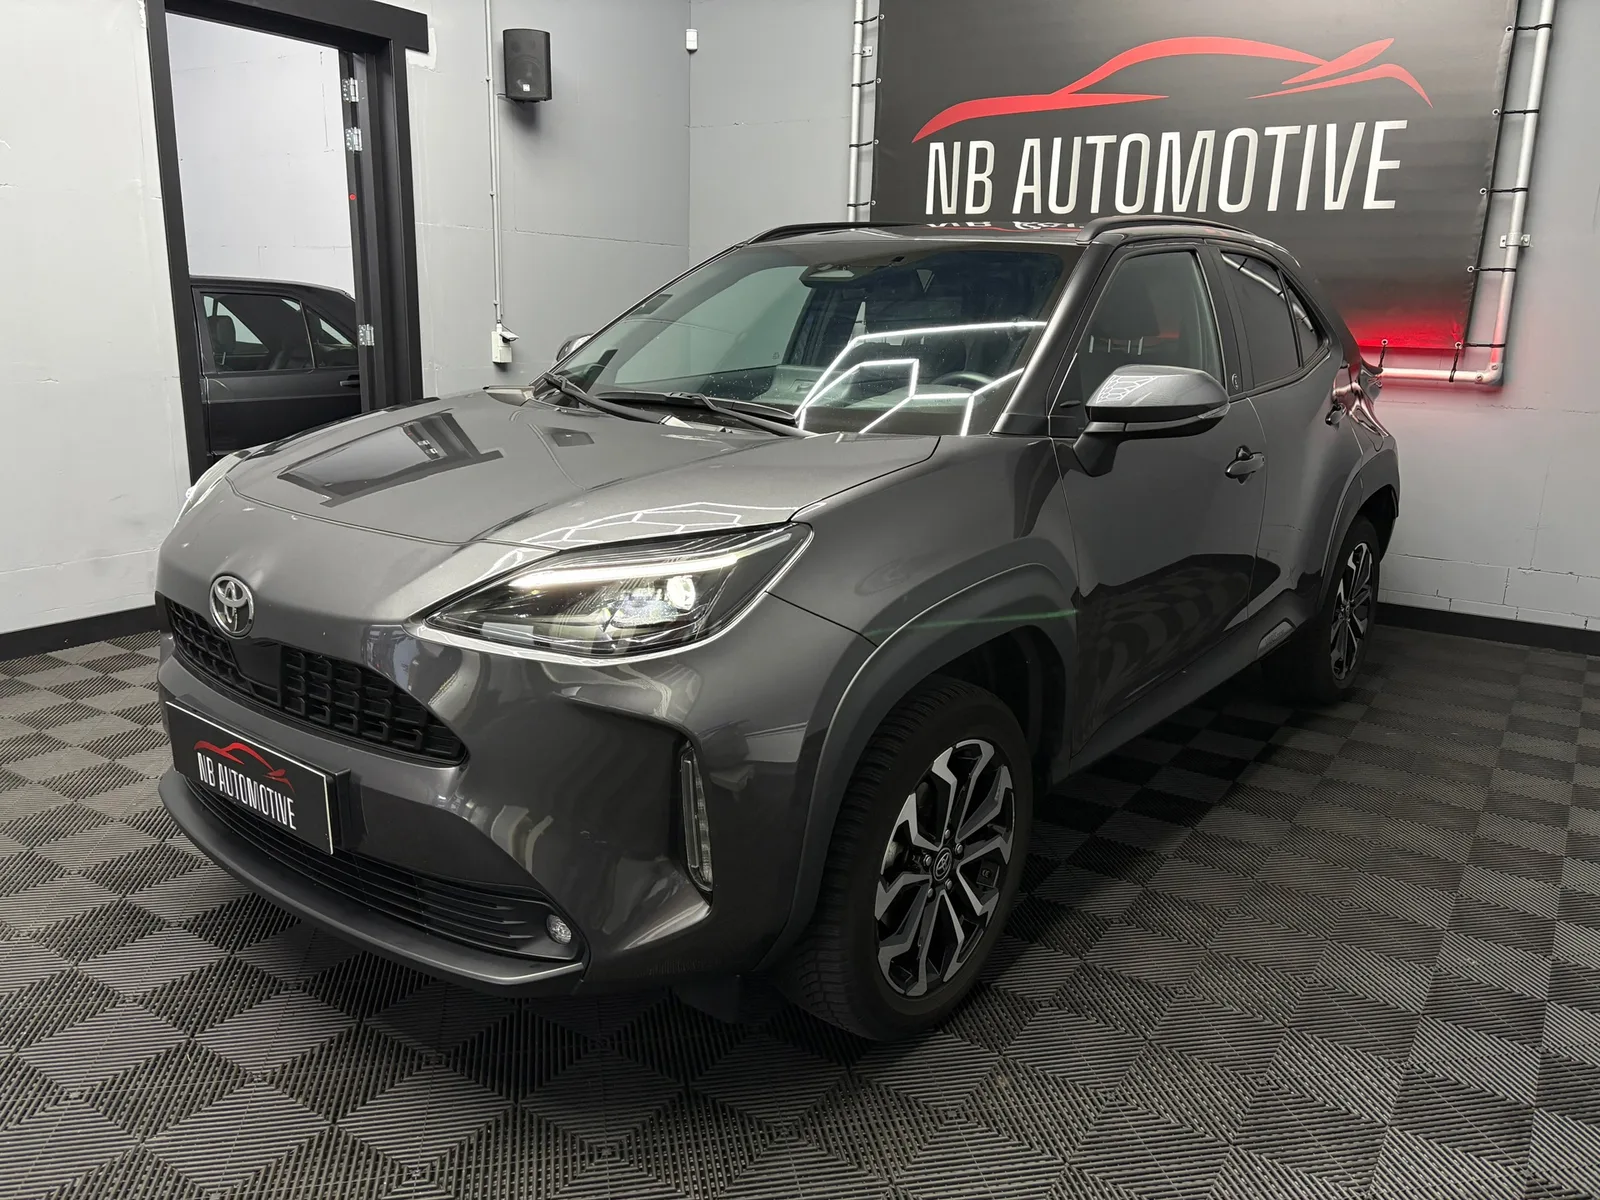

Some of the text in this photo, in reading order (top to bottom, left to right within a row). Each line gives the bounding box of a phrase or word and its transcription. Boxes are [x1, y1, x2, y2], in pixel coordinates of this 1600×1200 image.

[925, 119, 1407, 215] NB AUTOMOTIVE
[197, 752, 297, 830] NB AUTOMOTIVE
